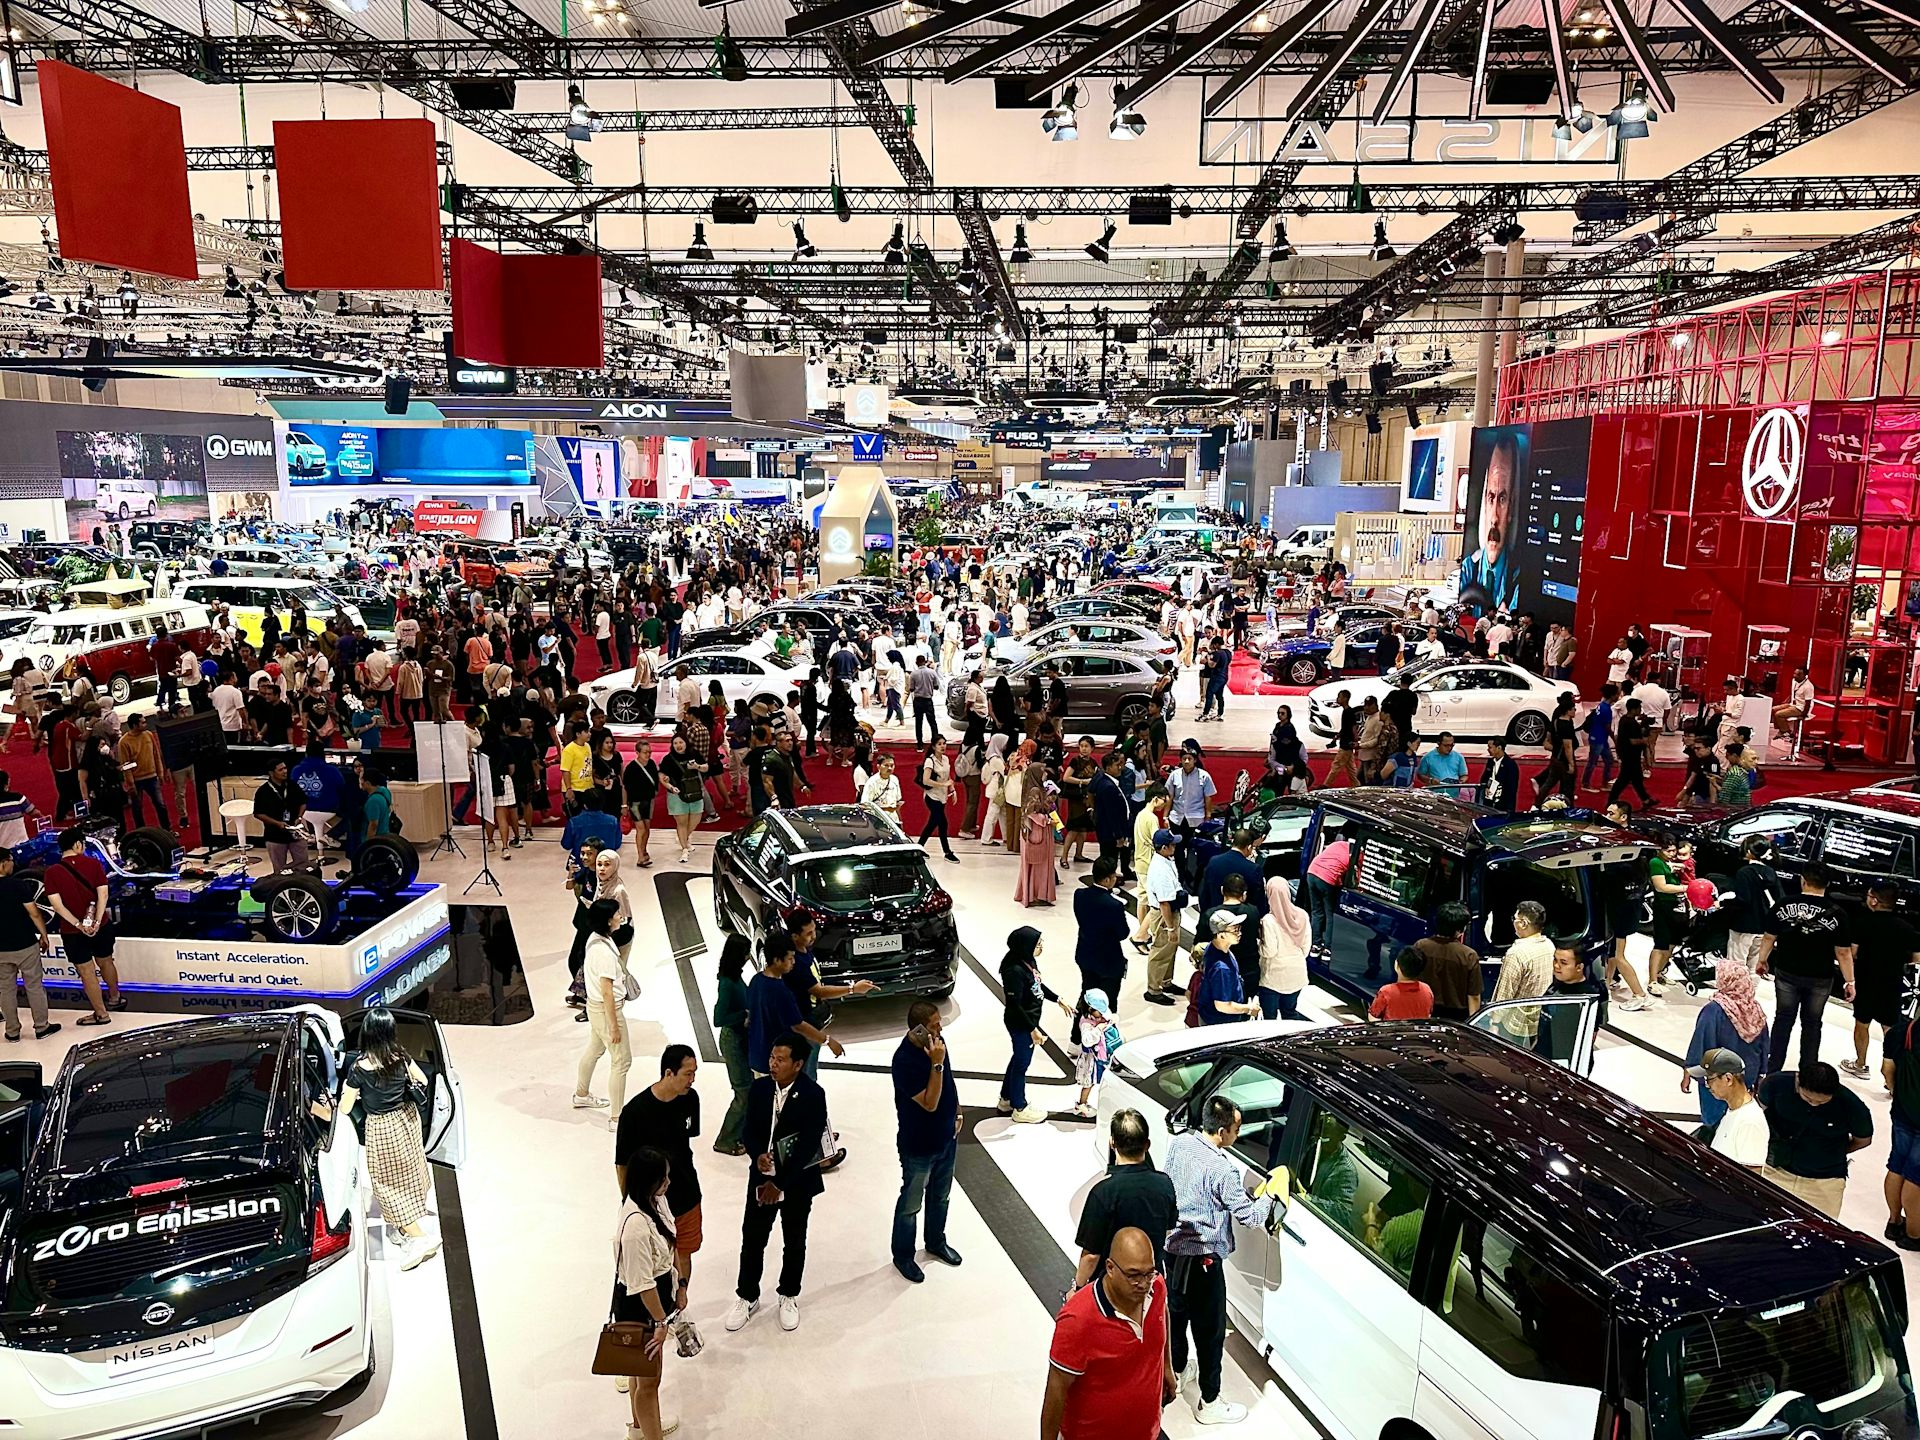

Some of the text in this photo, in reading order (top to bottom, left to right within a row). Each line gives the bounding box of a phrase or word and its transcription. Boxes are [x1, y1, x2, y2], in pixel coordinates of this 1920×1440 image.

[456, 370, 505, 384] GWM
[600, 403, 667, 418] AION
[1006, 431, 1038, 440] FUSO
[230, 439, 273, 456] GWM
[1428, 704, 1442, 717] 19
[857, 939, 898, 950] NISSAN
[176, 949, 309, 965] Instant Acceleration.
[178, 970, 303, 986] Powerful and Quiet.
[136, 1197, 281, 1235] Emission
[113, 1334, 207, 1365] NISSAN
